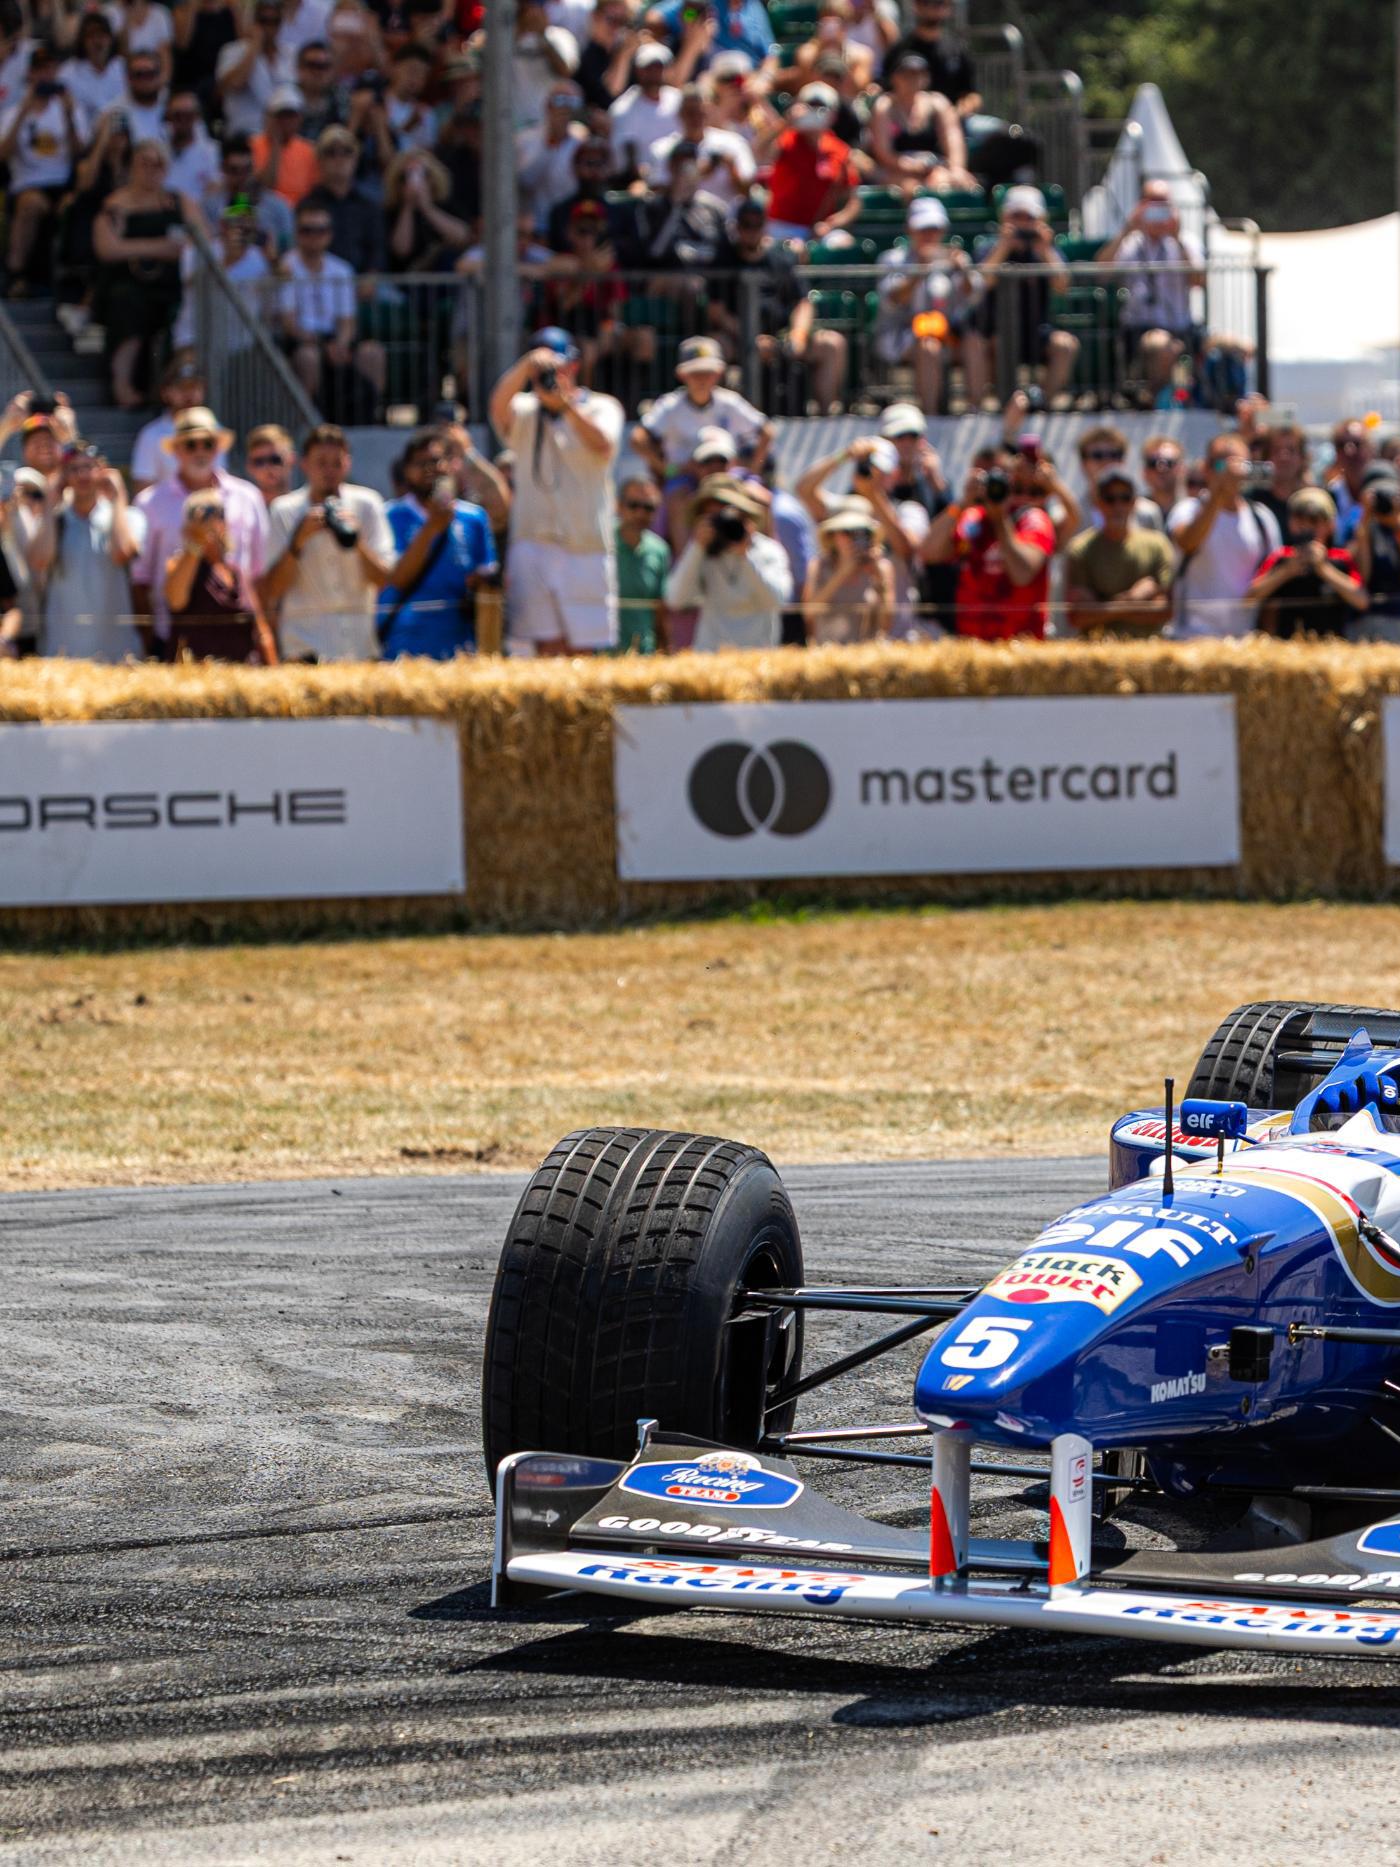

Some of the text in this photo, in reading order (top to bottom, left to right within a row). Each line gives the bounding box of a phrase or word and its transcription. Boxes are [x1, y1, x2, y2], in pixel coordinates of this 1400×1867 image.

[860, 751, 1178, 805] mastercard
[0, 788, 346, 831] ORSCHE
[1187, 1113, 1214, 1130] elf
[941, 1316, 1034, 1369] 5
[1151, 1369, 1206, 1404] KOMATSU
[661, 1468, 765, 1492] Racing
[680, 1487, 727, 1500] TEAM
[599, 1515, 853, 1551] GOODYEAR
[577, 1564, 855, 1605] Racing
